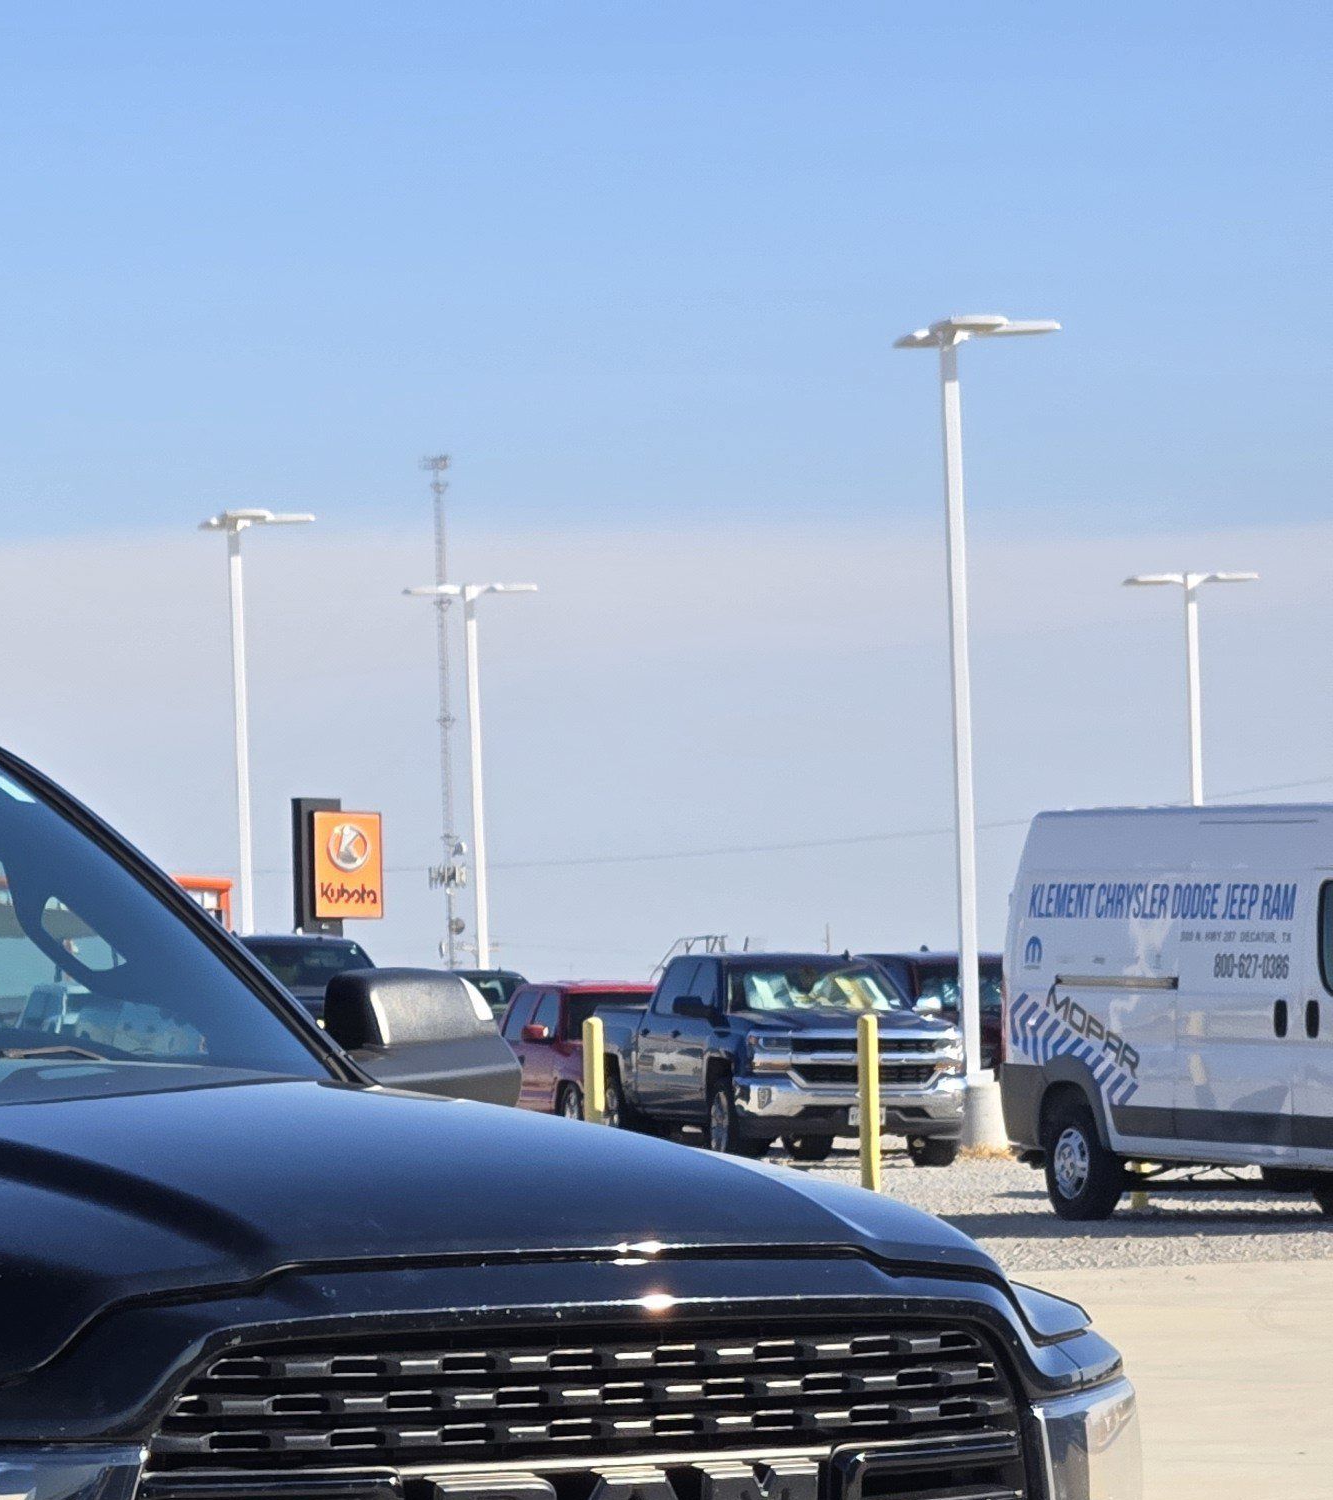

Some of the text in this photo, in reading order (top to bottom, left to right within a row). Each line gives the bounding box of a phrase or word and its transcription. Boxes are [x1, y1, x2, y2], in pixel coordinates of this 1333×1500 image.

[320, 882, 378, 904] Kubota
[1028, 883, 1297, 921] KLEMENT CHRYSLER DODGE JEEP RAM
[1214, 953, 1290, 979] 800-627-0386
[1046, 982, 1140, 1079] MOPAR
